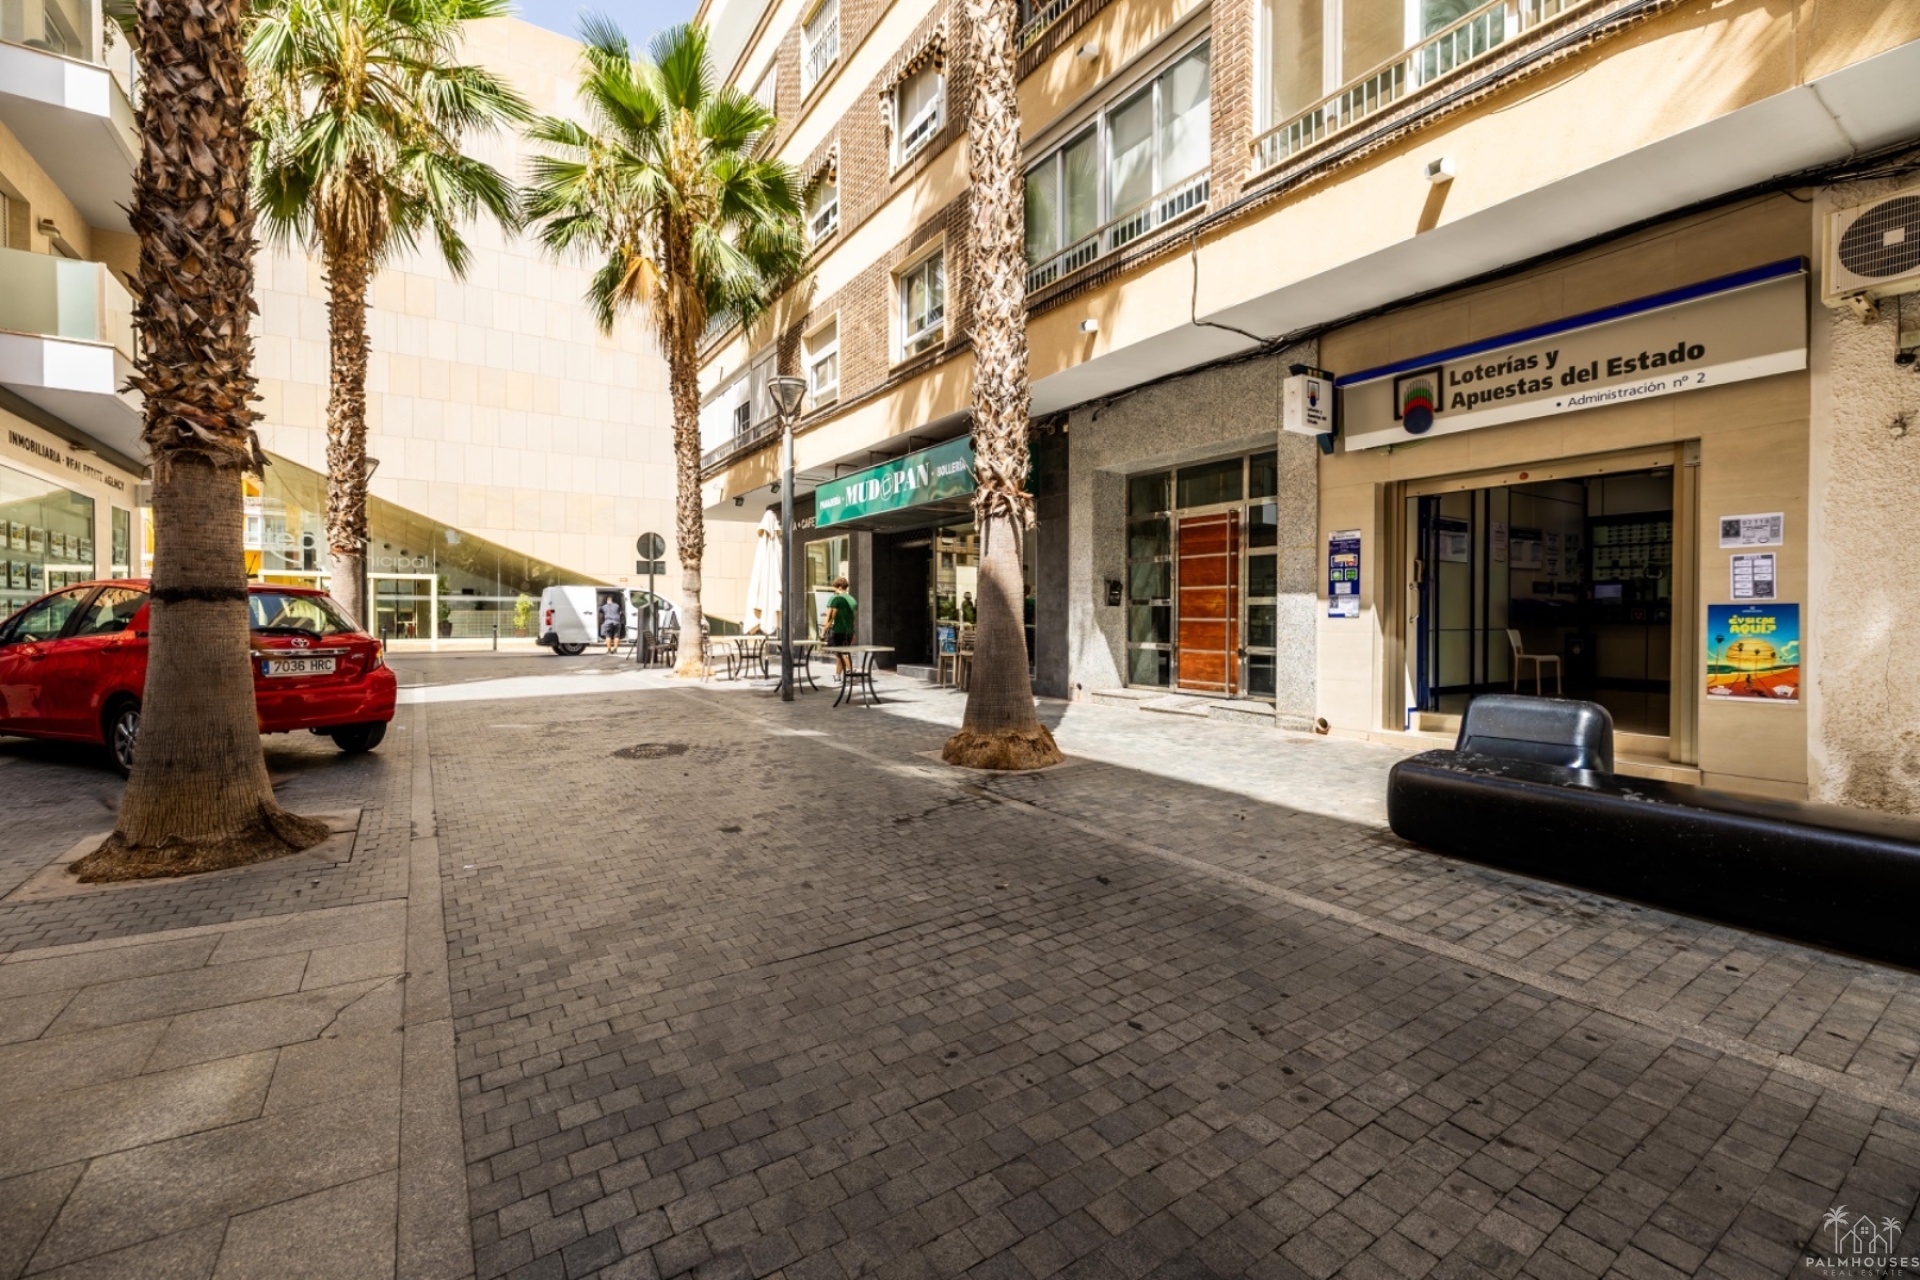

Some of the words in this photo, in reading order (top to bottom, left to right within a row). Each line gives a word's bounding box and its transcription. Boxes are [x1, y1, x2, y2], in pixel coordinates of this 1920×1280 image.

[1449, 355, 1538, 387] Loterías
[1545, 349, 1560, 371] y
[1450, 377, 1554, 410] Apuestas
[1560, 360, 1599, 387] del
[1606, 341, 1706, 377] Estado
[1567, 379, 1666, 407] Administración
[1696, 371, 1706, 384] 2
[8, 429, 61, 464] INMOBILIARIA
[66, 456, 82, 473] REAL
[273, 660, 305, 672] 7036
[310, 659, 332, 671] HRC
